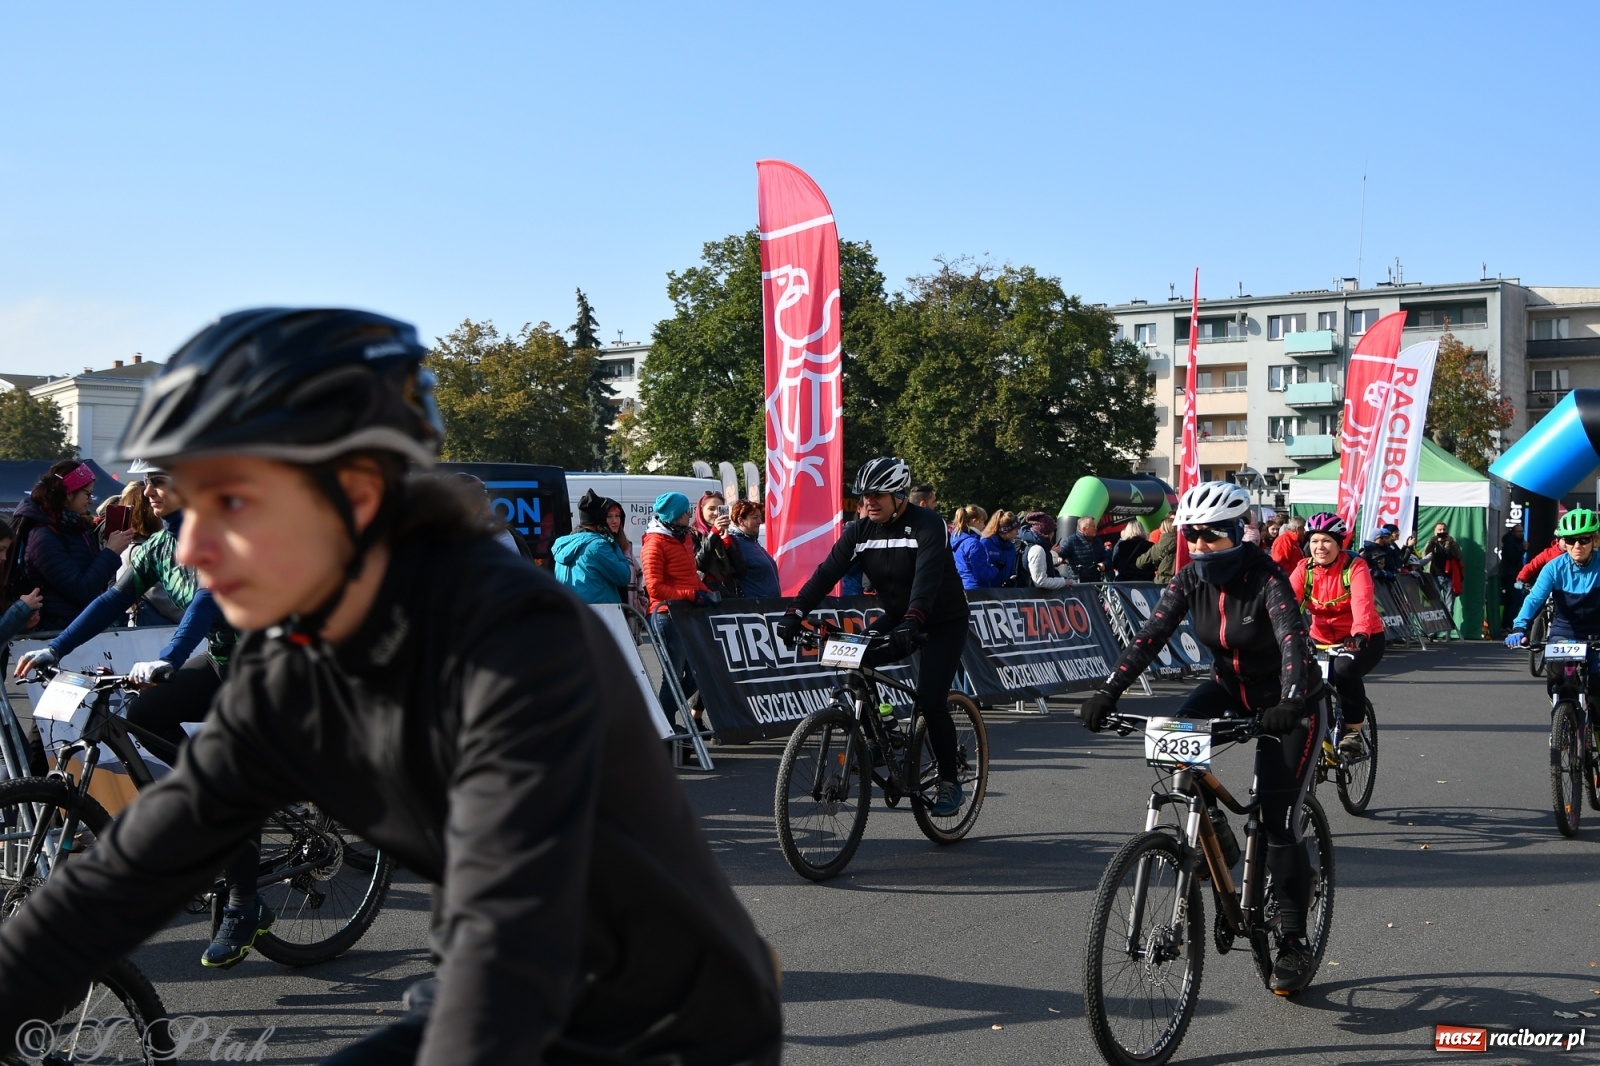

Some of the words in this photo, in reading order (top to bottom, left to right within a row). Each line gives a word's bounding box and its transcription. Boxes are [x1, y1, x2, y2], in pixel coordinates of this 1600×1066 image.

[970, 597, 1092, 648] TREZADO
[830, 644, 858, 658] 2622
[1552, 646, 1580, 654] 3179
[996, 661, 1062, 690] USZCZELNIAMY
[747, 687, 833, 724] USZCZELNIAM
[1159, 738, 1201, 757] 3283
